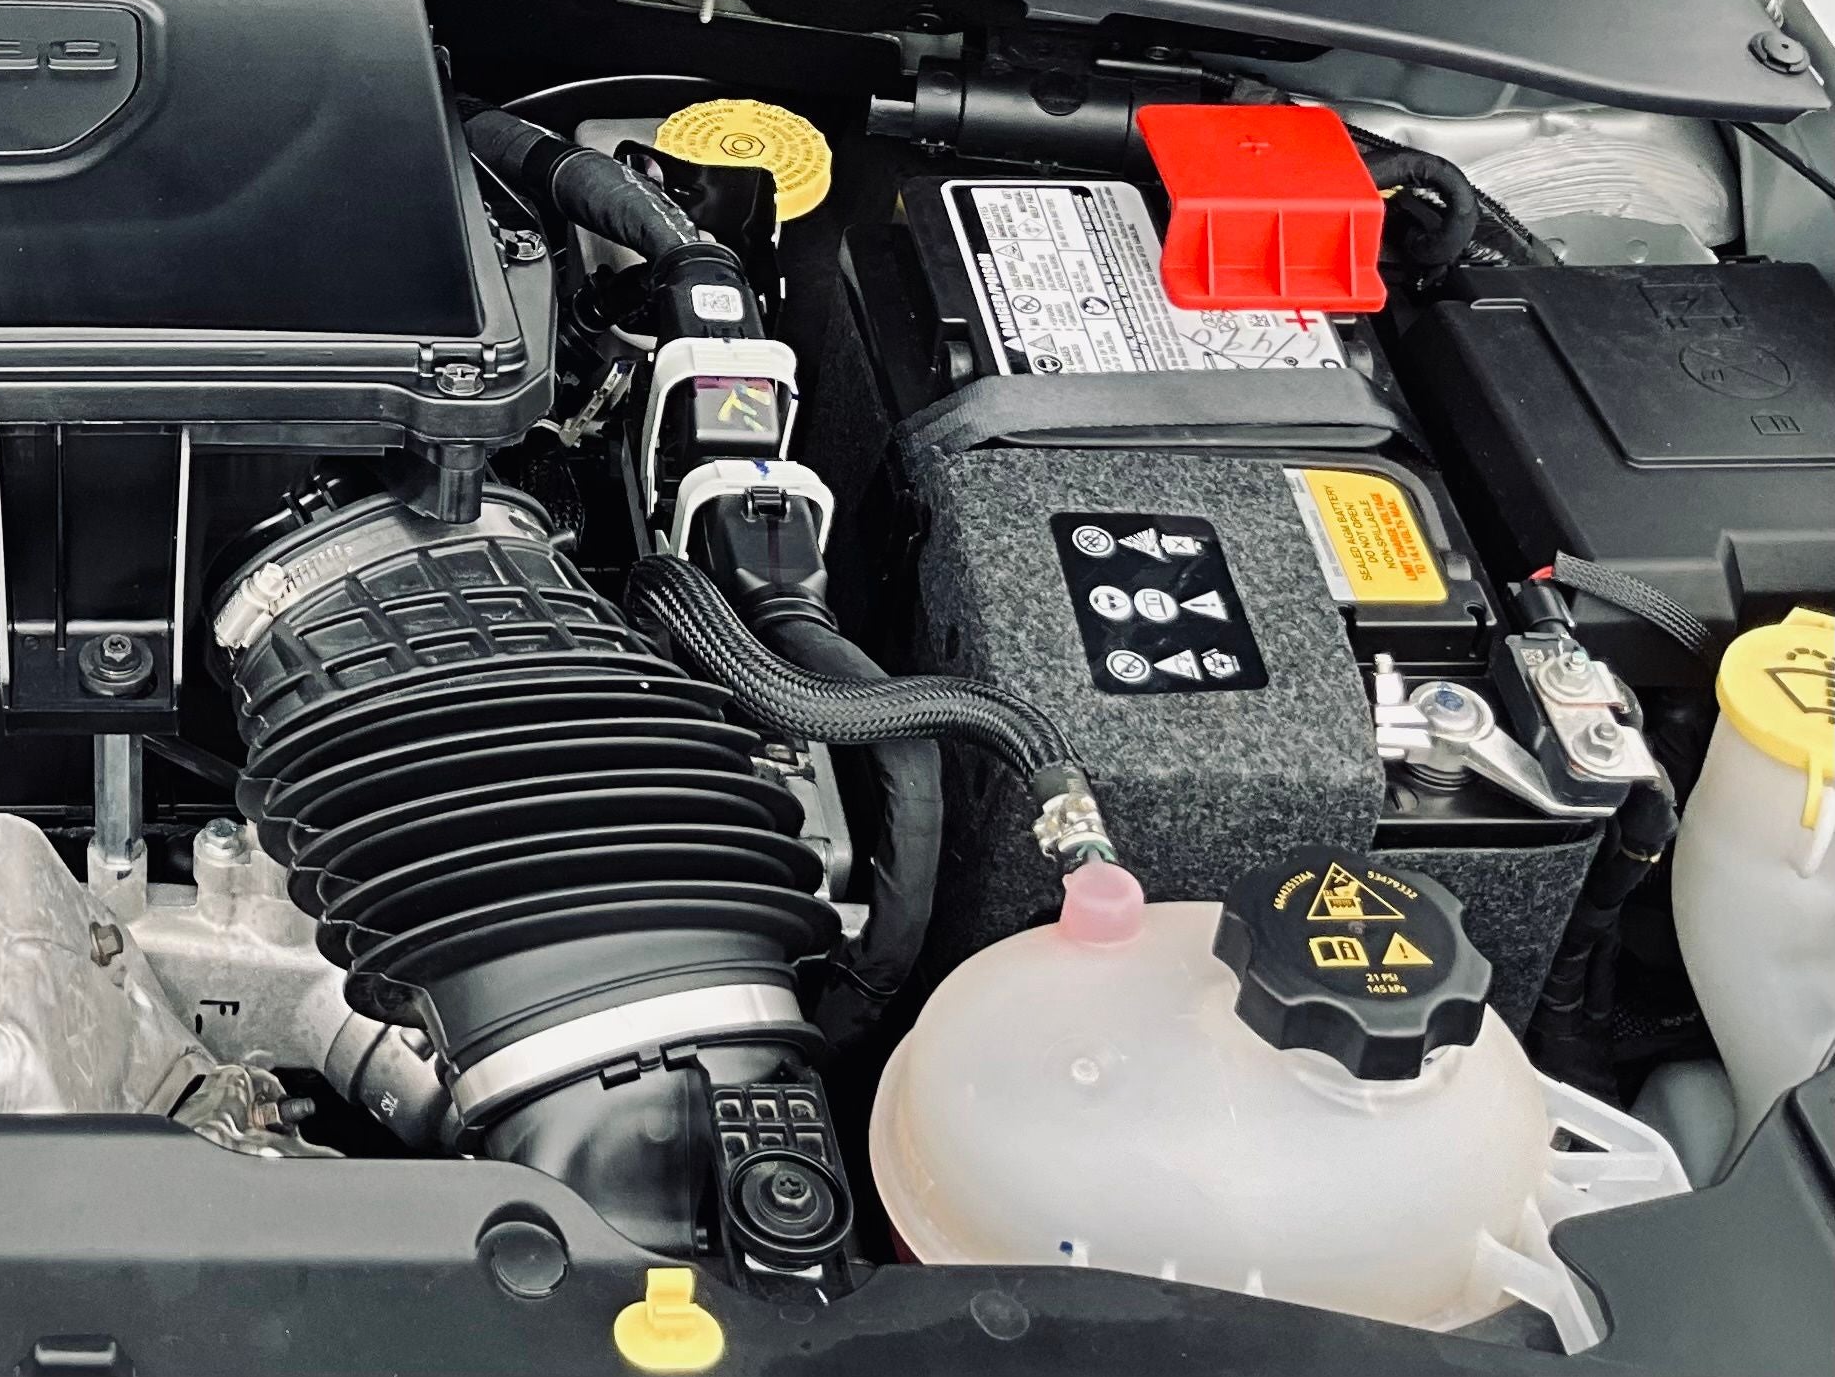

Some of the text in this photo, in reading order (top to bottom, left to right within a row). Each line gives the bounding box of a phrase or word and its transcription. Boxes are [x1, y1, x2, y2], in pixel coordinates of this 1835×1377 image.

[1323, 485, 1372, 580] SEALED AGM BATTERY
[1355, 531, 1371, 548] NOT
[1358, 500, 1397, 568] NON-SPILLABLE
[1364, 550, 1378, 562] DO
[1369, 493, 1418, 580] LIMIT CHARGE VOLTAGE
